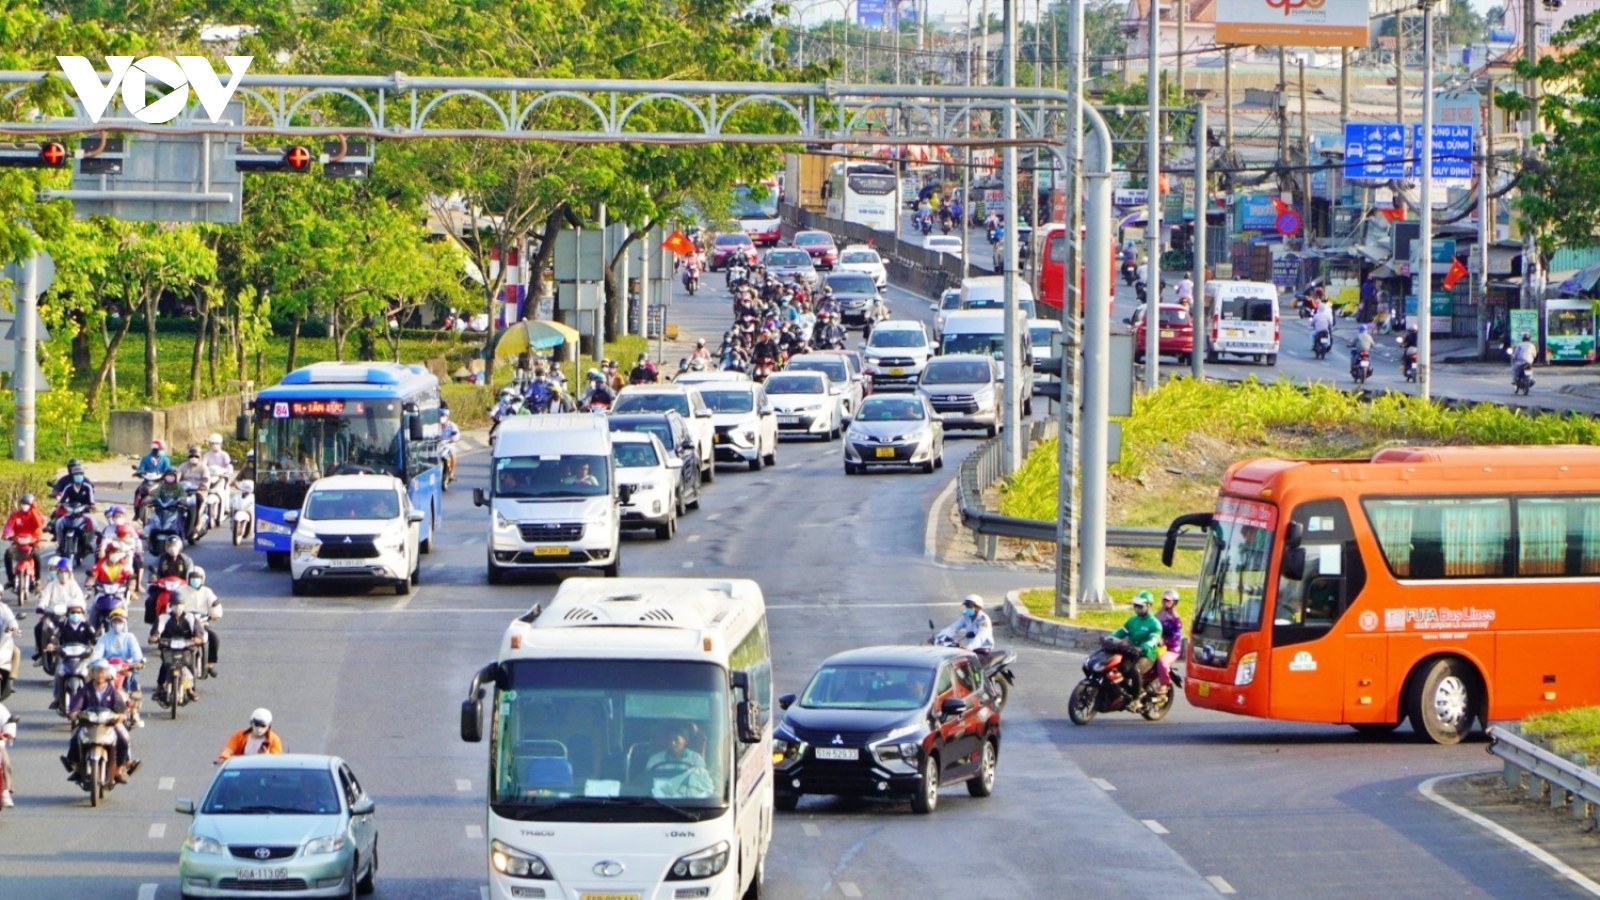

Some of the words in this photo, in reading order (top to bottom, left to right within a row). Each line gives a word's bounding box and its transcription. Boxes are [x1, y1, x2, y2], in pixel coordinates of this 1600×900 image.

[1433, 125, 1450, 136] ÚNG
[275, 405, 287, 416] 84
[1405, 607, 1437, 620] FUTA
[1439, 607, 1462, 620] Bus
[1464, 607, 1495, 620] Lines
